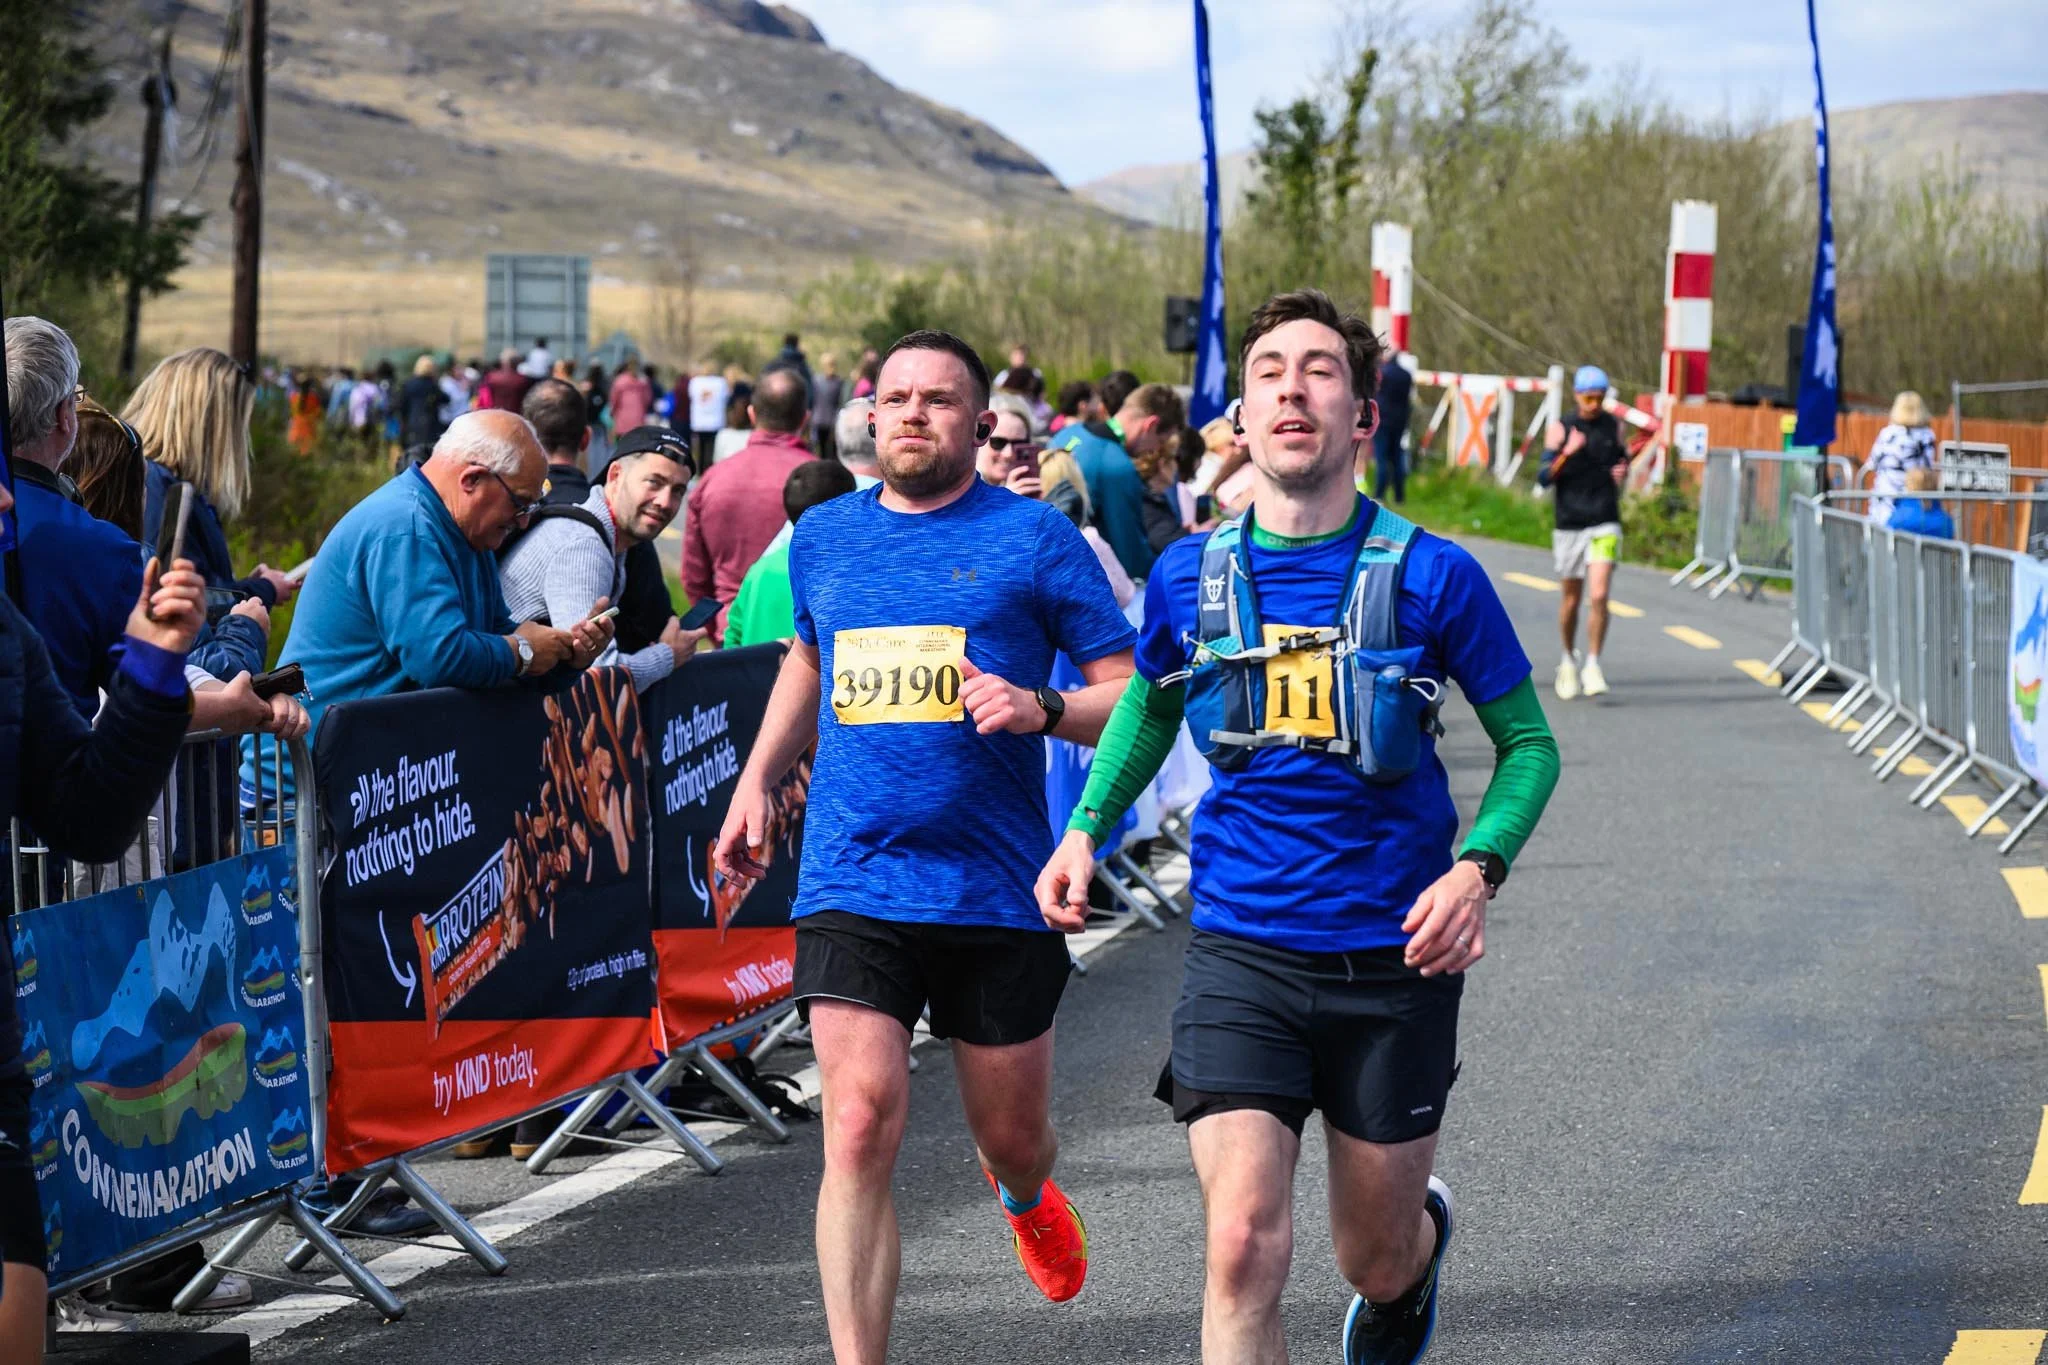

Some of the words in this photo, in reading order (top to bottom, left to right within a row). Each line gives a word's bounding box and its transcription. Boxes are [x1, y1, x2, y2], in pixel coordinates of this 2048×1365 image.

[834, 664, 960, 709] 39190
[1272, 674, 1332, 720] 11
[662, 719, 676, 766] all
[675, 714, 693, 757] the
[693, 700, 729, 747] flavour.
[350, 774, 370, 829] all
[370, 767, 395, 818] the
[398, 749, 459, 806] flavour.
[665, 761, 708, 816] nothing
[704, 752, 716, 791] to
[714, 737, 740, 784] hide.
[345, 823, 415, 887] nothing
[413, 812, 434, 857] to
[434, 793, 476, 849] hide.
[440, 860, 505, 956] PROTEIN
[431, 943, 446, 973] KIND
[723, 976, 747, 1008] try
[734, 963, 770, 999] KIND
[433, 1071, 453, 1116] try
[455, 1053, 490, 1101] KIND
[494, 1043, 538, 1088] today.
[62, 1108, 257, 1219] CONNEMARATHON
